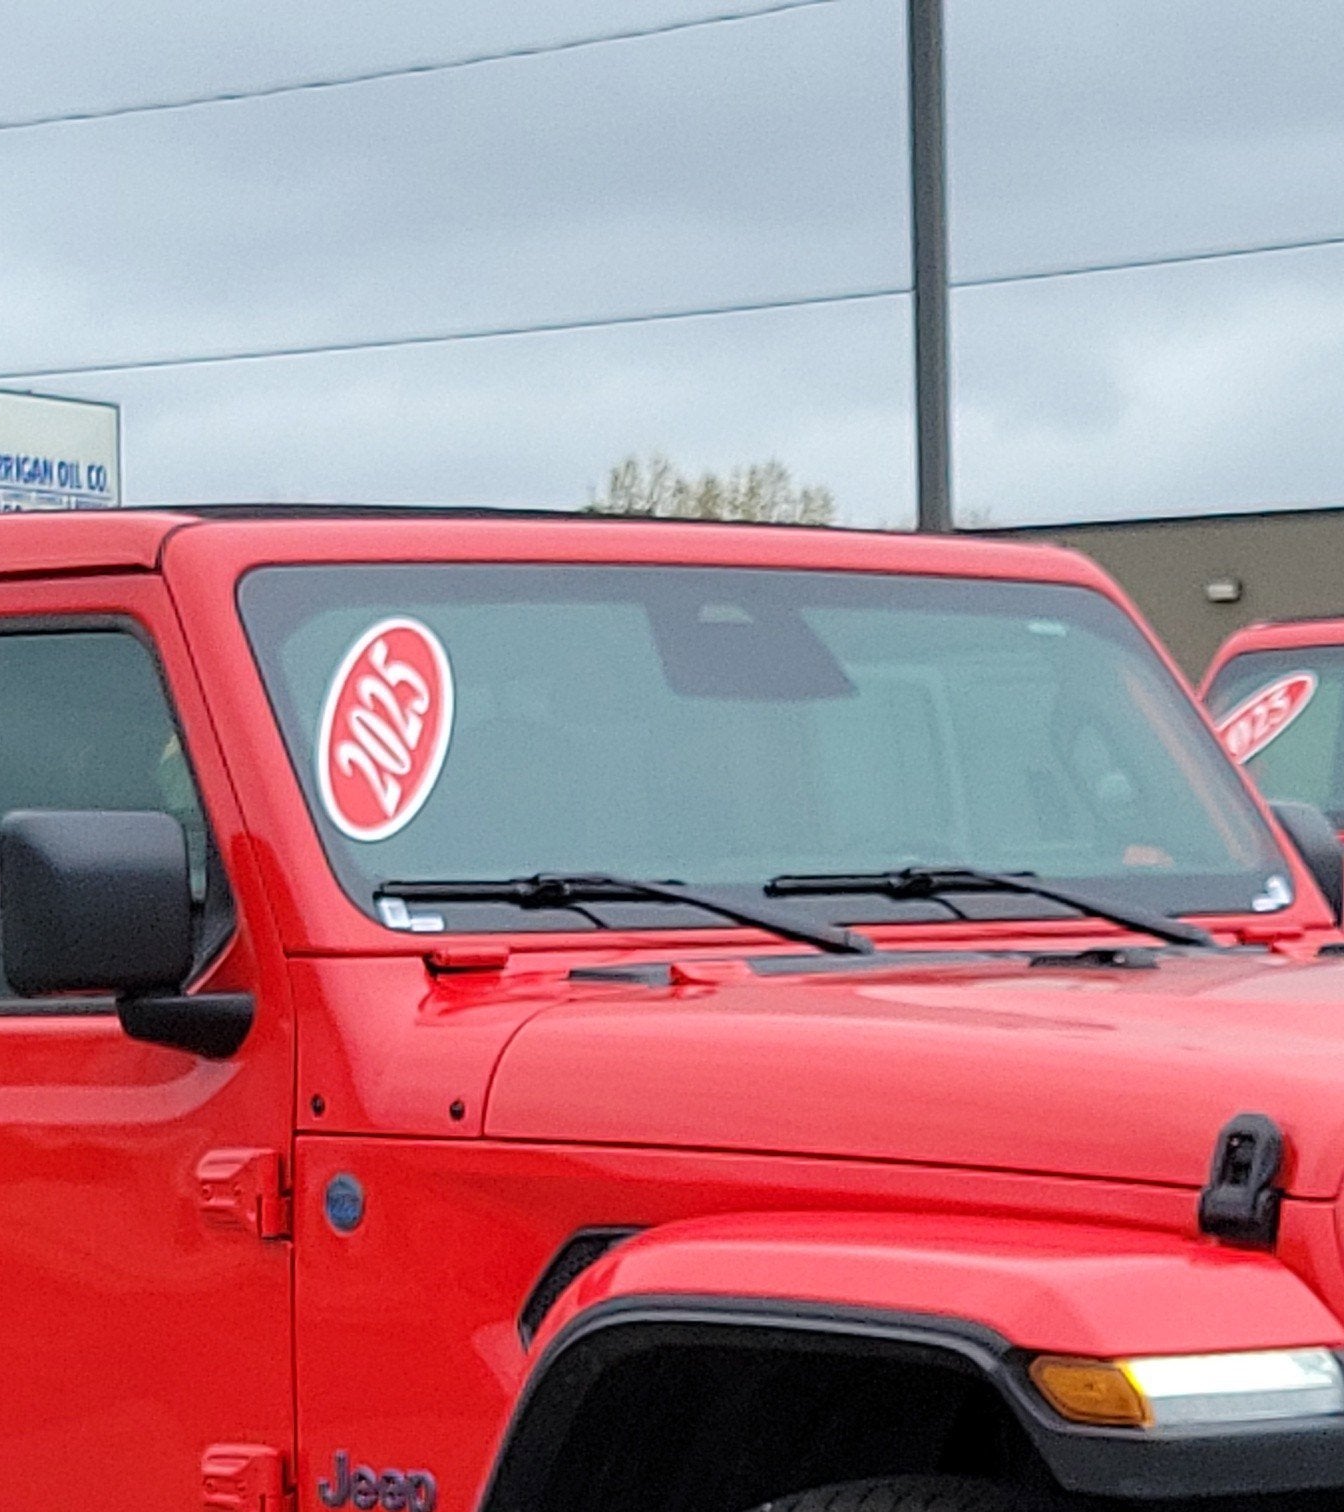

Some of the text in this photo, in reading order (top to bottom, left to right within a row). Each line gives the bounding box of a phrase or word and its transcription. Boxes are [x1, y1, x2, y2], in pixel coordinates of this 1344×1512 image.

[57, 461, 82, 490] OIL
[334, 637, 431, 819] 2025
[1220, 687, 1292, 757] 025
